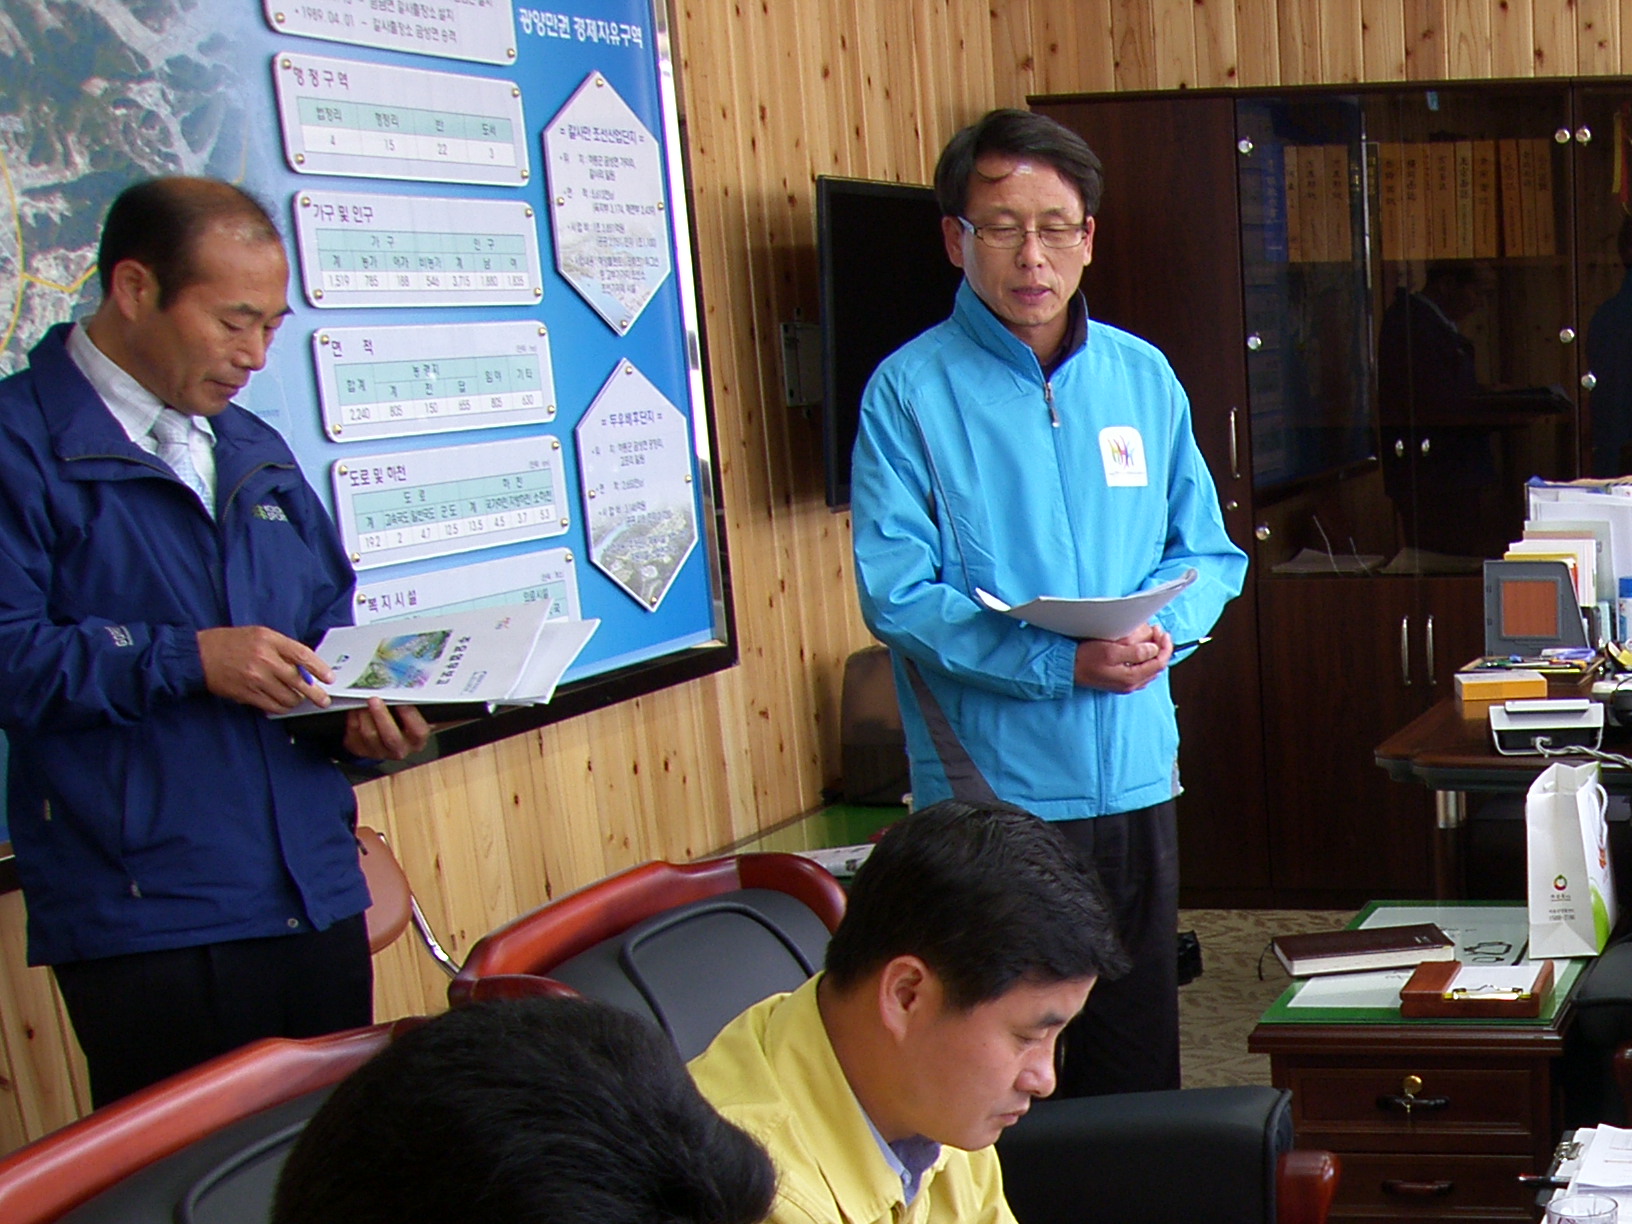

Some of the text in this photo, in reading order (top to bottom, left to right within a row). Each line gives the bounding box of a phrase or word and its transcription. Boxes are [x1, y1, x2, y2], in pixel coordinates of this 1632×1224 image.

[519, 8, 644, 49] 광양만권 경제자유구역
[352, 206, 374, 223] 인구
[364, 273, 379, 288] 785
[350, 469, 371, 487] 도로
